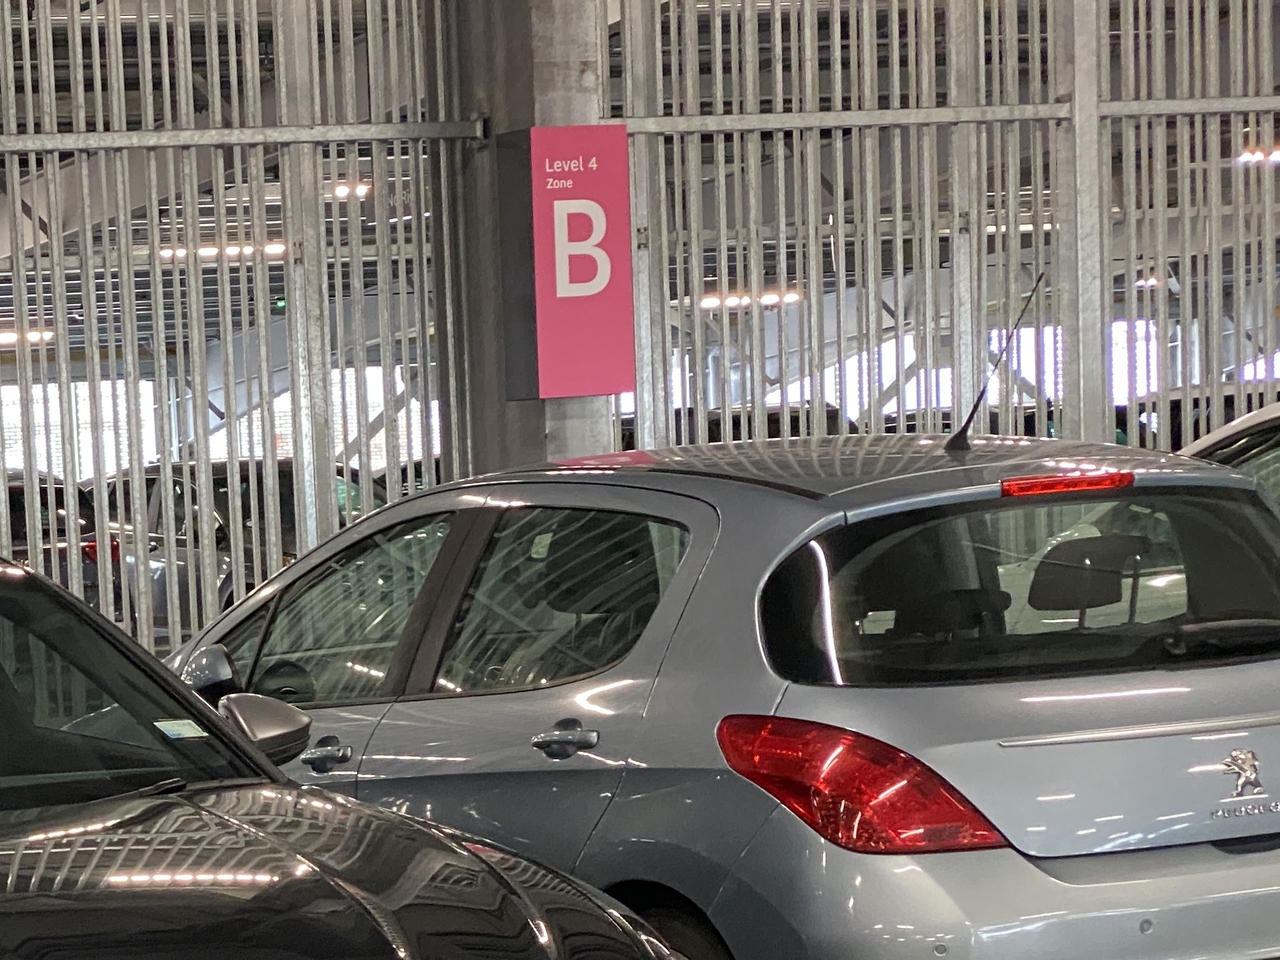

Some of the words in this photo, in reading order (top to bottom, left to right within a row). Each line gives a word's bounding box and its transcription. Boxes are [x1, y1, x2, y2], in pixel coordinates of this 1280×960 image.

[545, 156, 583, 173] Level
[588, 157, 598, 171] 4
[546, 178, 573, 189] Zone
[553, 199, 611, 298] B
